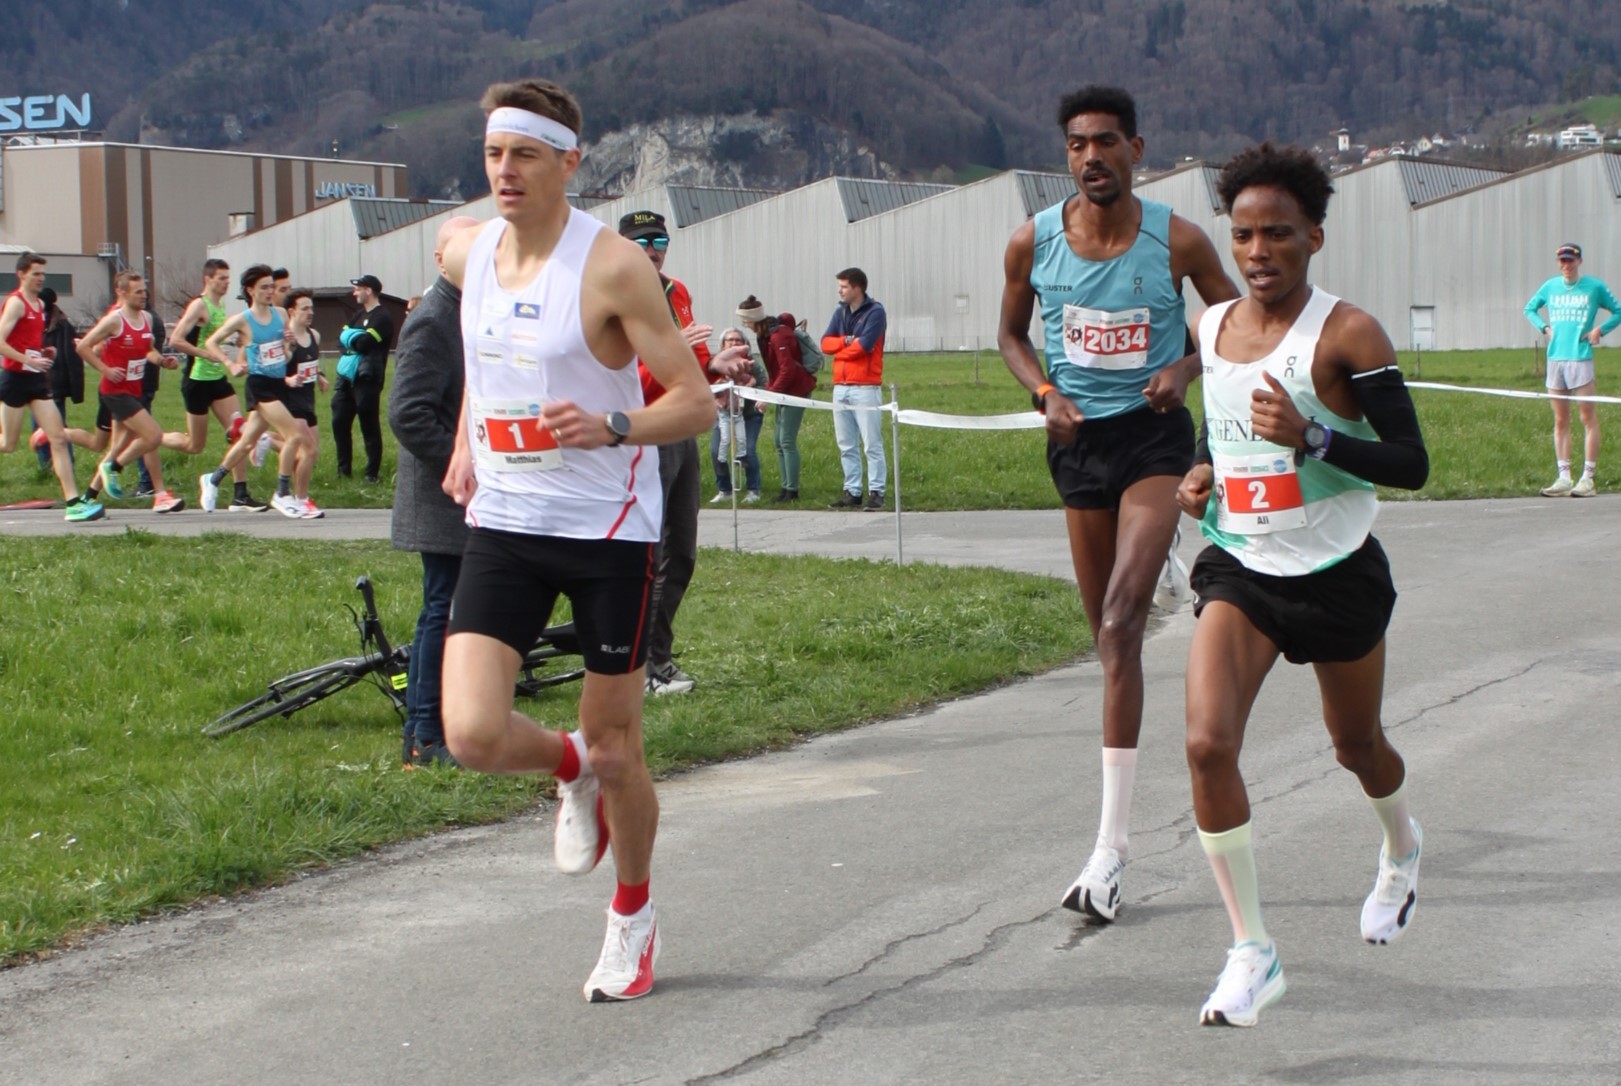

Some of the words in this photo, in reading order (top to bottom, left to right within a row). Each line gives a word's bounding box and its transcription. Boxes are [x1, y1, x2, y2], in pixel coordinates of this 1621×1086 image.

[1085, 327, 1147, 352] 2034
[507, 422, 525, 449] 1
[505, 456, 542, 464] Matthias
[1248, 480, 1270, 509] 2
[1257, 516, 1269, 525] Ali
